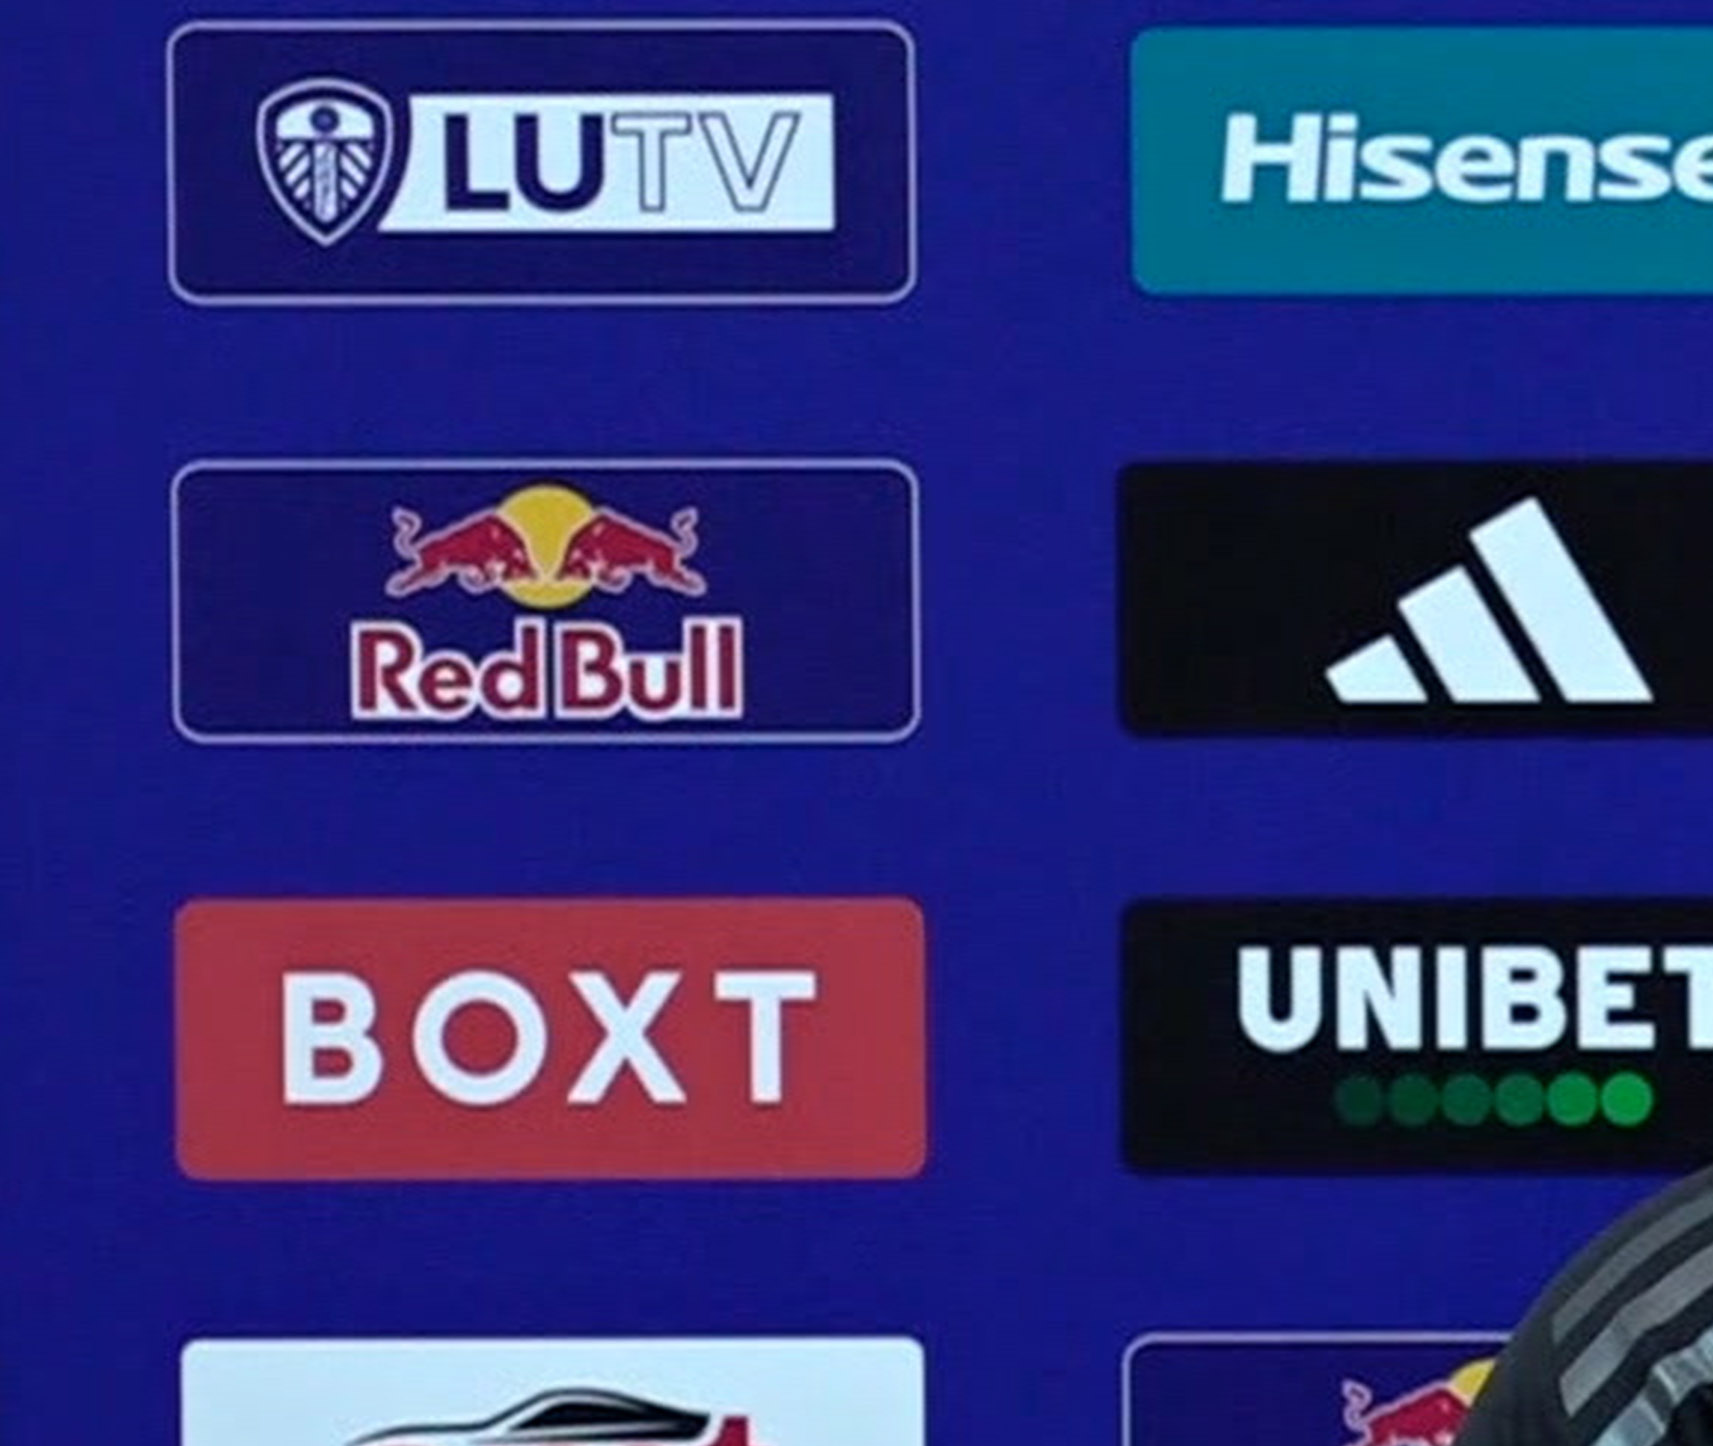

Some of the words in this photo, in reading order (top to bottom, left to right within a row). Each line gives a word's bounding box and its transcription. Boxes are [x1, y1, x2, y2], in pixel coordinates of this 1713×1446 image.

[444, 111, 801, 213] LUTV
[351, 617, 547, 720] Red
[555, 616, 743, 722] Bull
[281, 969, 817, 1106] BOXT
